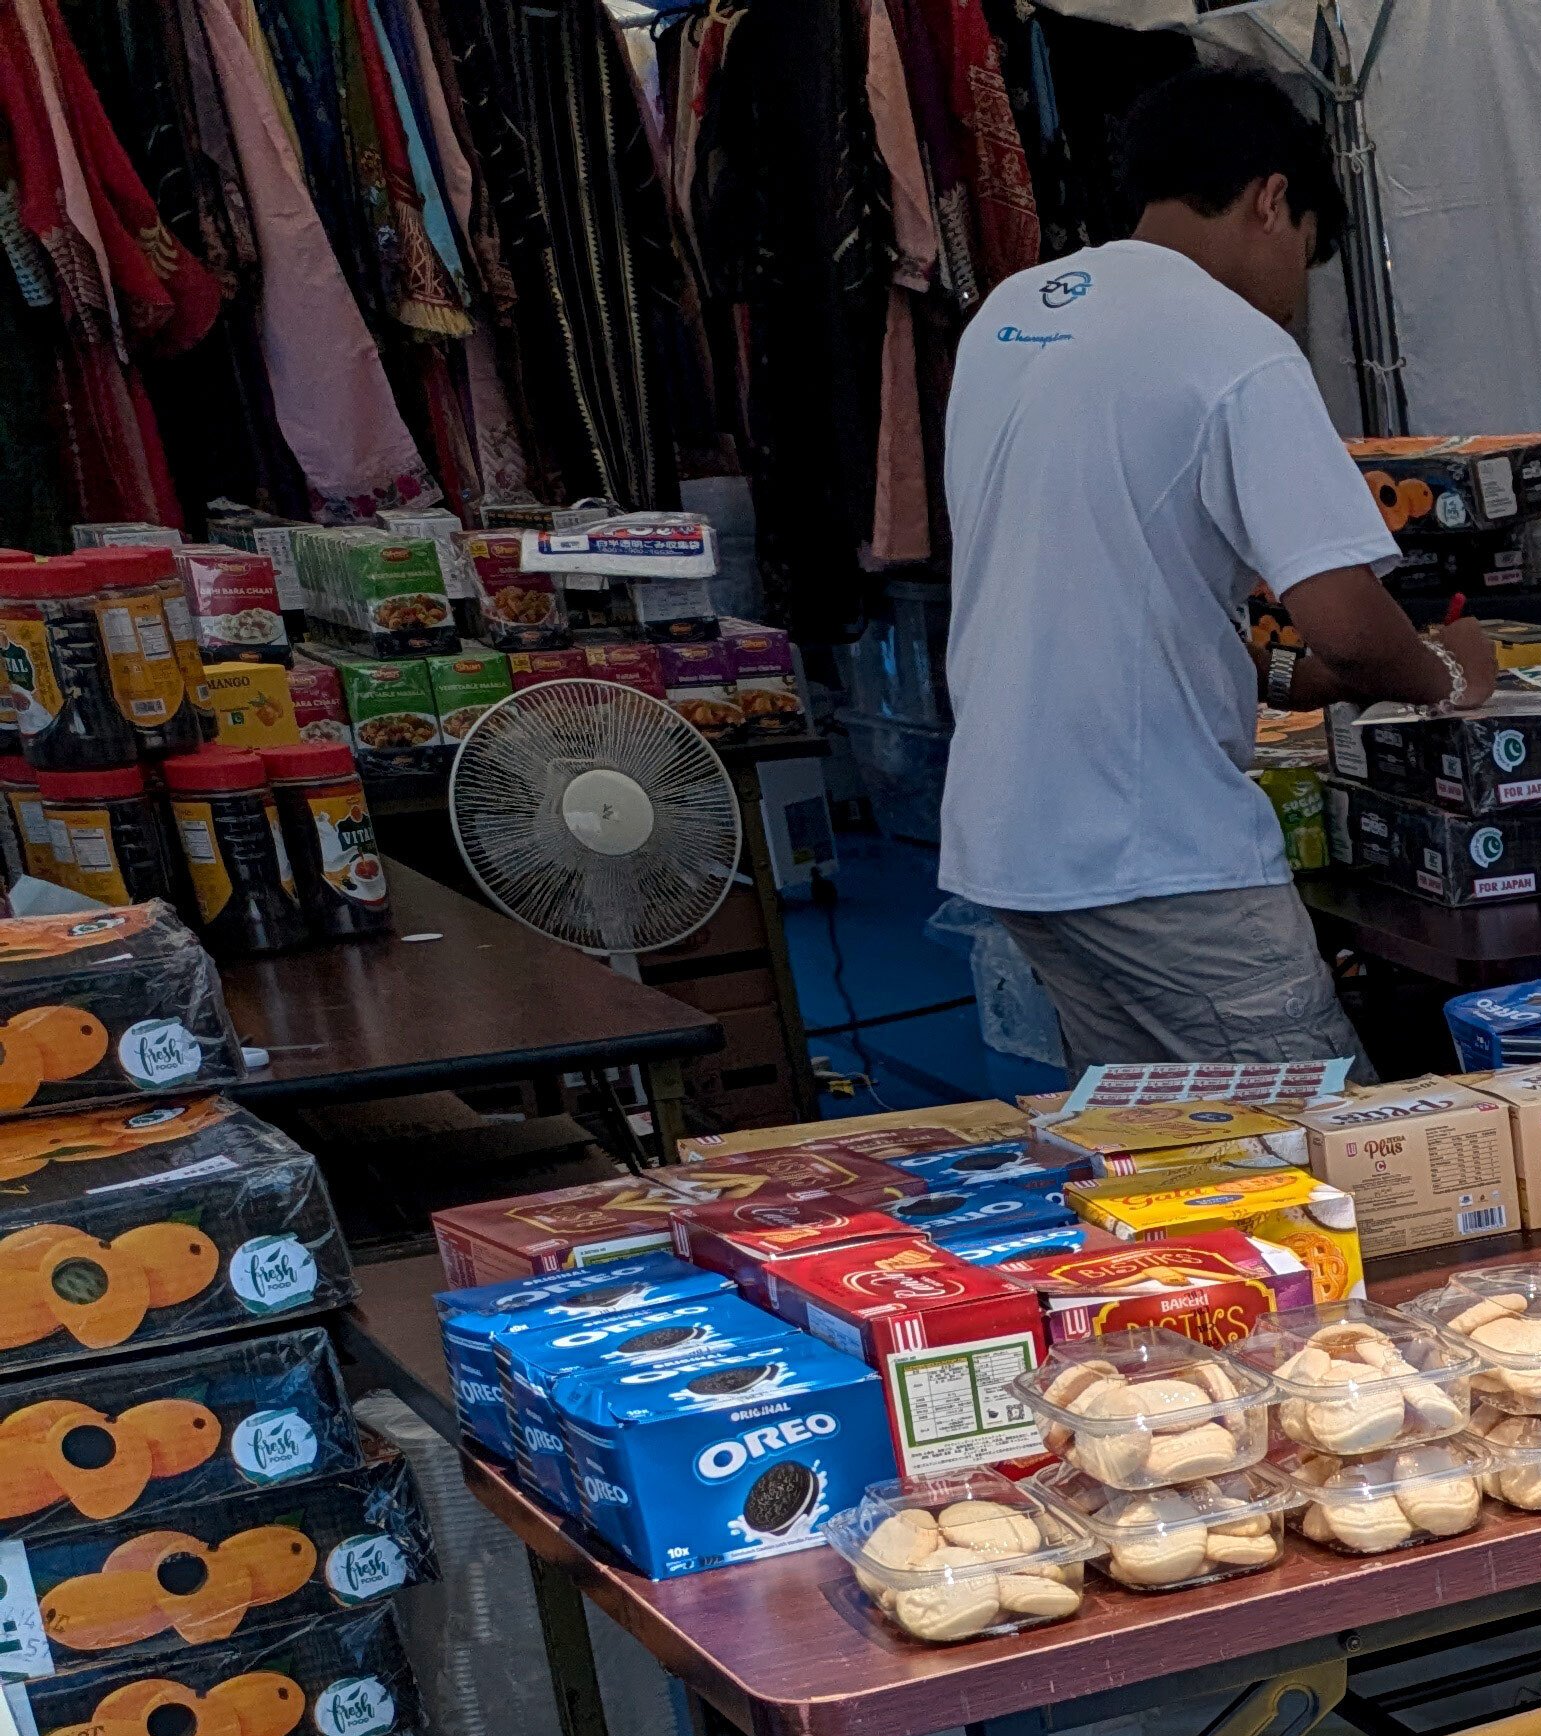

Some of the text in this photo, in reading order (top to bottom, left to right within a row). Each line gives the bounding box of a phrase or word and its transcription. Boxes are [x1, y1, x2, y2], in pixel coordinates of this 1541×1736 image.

[996, 325, 1074, 348] Champion
[1503, 785, 1523, 798] FOR
[1479, 878, 1532, 893] FOR JAPAN
[139, 1037, 182, 1077] fresh
[156, 1062, 178, 1071] FOOD
[1363, 1138, 1405, 1161] Plus
[1121, 1186, 1205, 1211] Gala
[247, 1254, 297, 1298] fresh
[1078, 1250, 1206, 1281] BISTIKS
[268, 1281, 291, 1291] FOOD
[497, 1265, 646, 1311] OREO
[1160, 1294, 1210, 1313] BAKERI
[551, 1305, 710, 1348] OREO
[894, 1317, 924, 1350] LU
[1064, 1308, 1088, 1338] LU
[619, 1347, 784, 1386] OREO
[730, 1401, 792, 1422] ORIGINAL
[253, 1433, 300, 1469] fresh
[524, 1425, 564, 1453] OREO
[697, 1413, 837, 1479] OREO
[268, 1453, 293, 1463] FOOD
[582, 1474, 629, 1504] OREO
[666, 1546, 690, 1558] 10x
[345, 1554, 390, 1594] fresh
[330, 1697, 375, 1733] fresh
